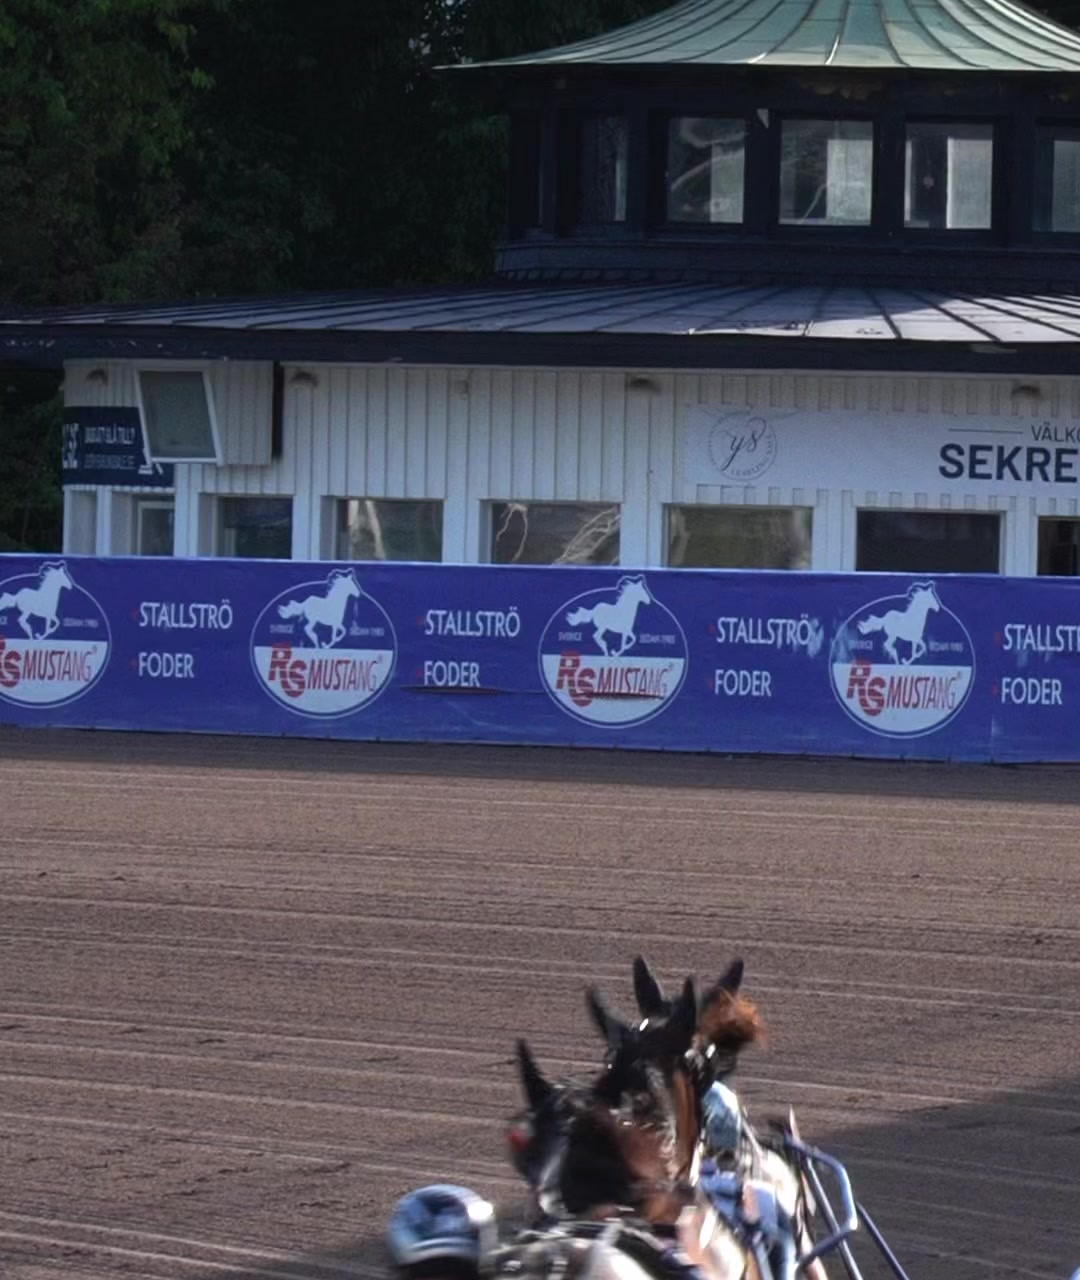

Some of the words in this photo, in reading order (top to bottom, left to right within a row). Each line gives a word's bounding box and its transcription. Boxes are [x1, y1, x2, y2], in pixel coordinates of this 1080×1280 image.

[139, 599, 233, 629] STALLSTRÖ
[424, 607, 521, 637] STALLSTRÖ
[717, 614, 813, 646] STALLSTRÖ
[22, 649, 92, 682] MUSTANG
[139, 652, 195, 678] FODER
[307, 659, 377, 691] MUSTANG
[424, 661, 480, 688] FODER
[714, 669, 771, 697] FODER
[886, 675, 956, 709] MUSTANG
[1001, 677, 1062, 705] FODER
